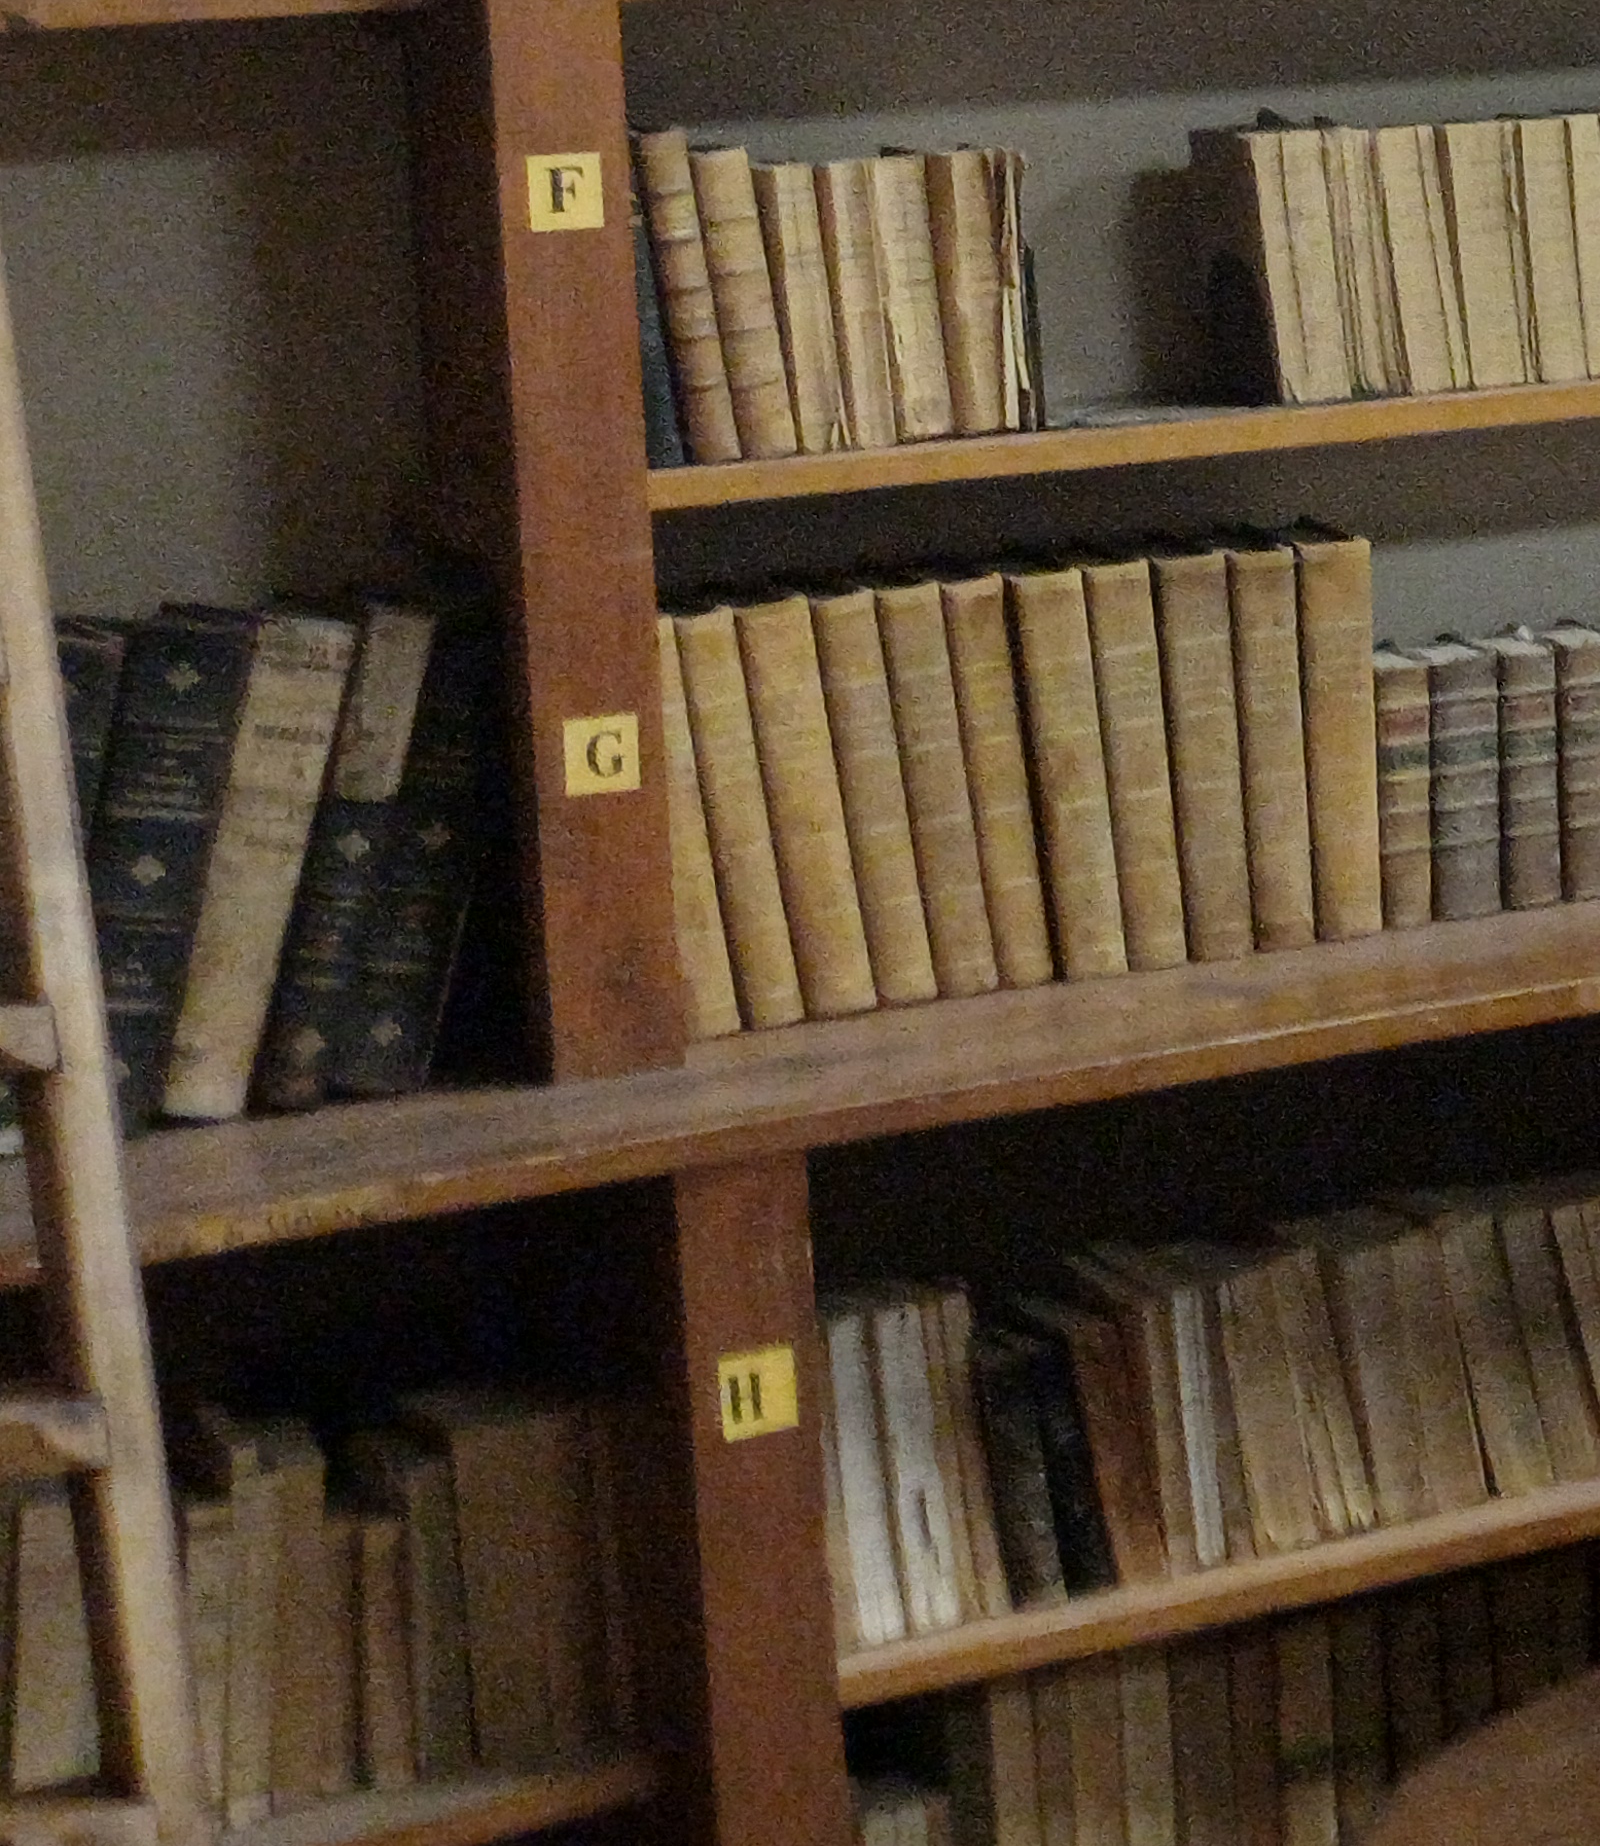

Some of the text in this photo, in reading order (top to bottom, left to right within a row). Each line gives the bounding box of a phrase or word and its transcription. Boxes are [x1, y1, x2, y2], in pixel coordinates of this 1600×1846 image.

[545, 165, 584, 214] F
[586, 731, 623, 778] G
[728, 1372, 763, 1425] H
